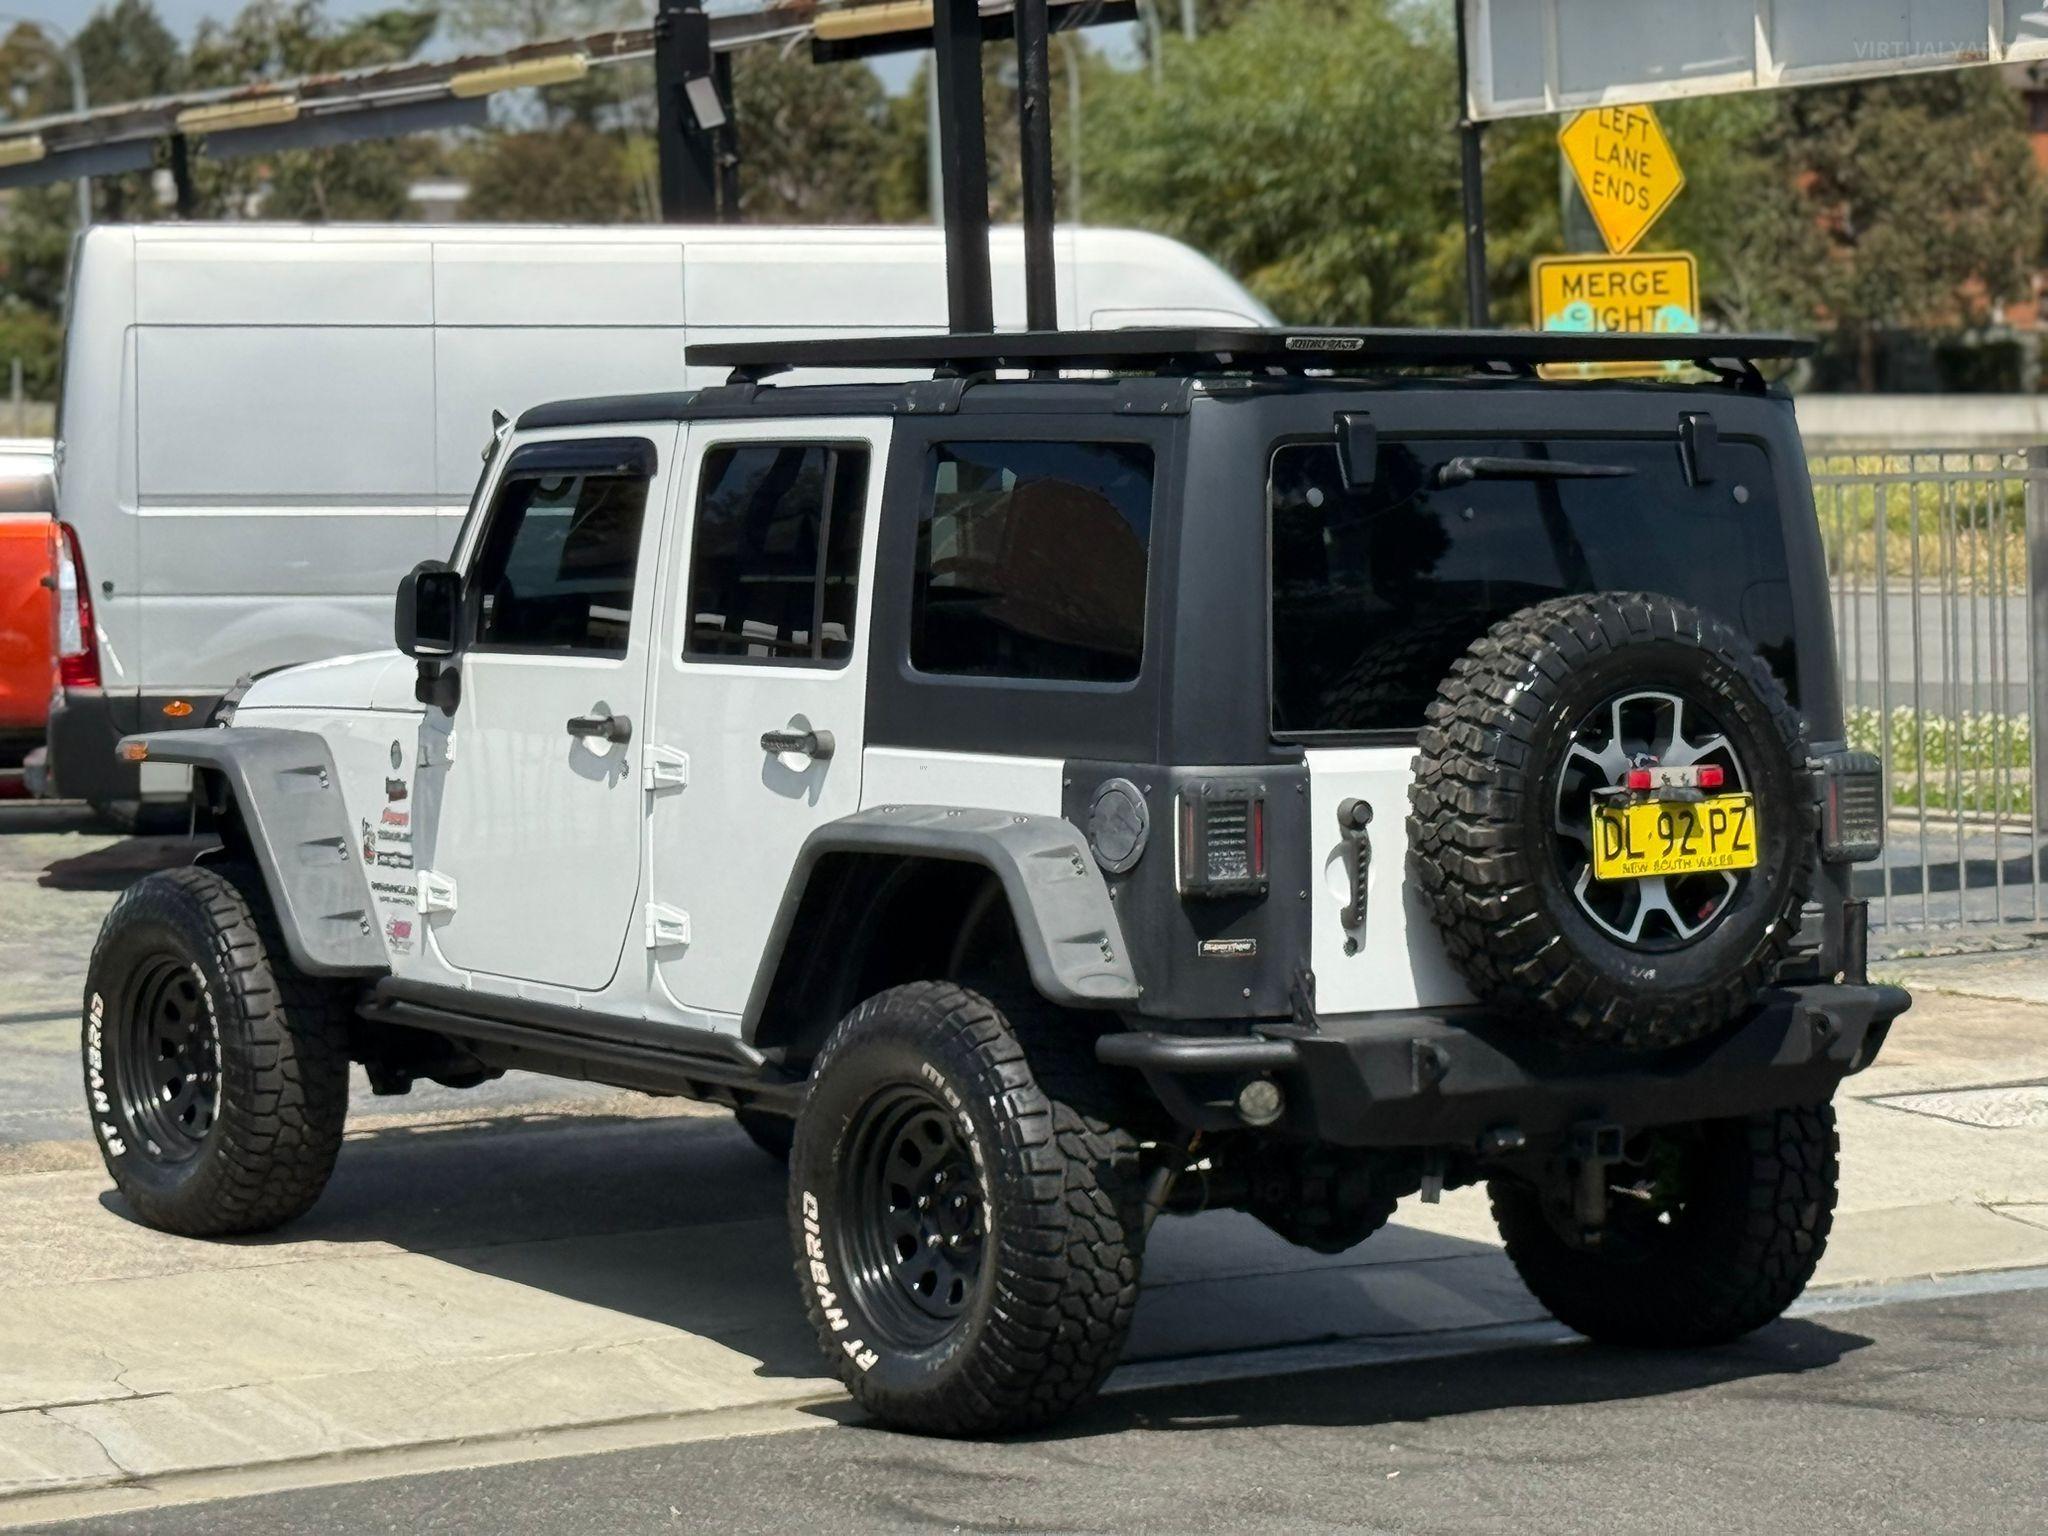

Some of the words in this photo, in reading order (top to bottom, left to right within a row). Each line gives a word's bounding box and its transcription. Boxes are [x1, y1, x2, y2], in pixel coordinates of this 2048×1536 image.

[1598, 106, 1650, 141] LEFT
[1594, 134, 1651, 178] LANE
[1592, 171, 1650, 211] ENDS
[1562, 270, 1670, 299] MERGE
[1604, 815, 1645, 861] DL
[1657, 810, 1697, 857] 92
[1709, 807, 1750, 853] PZ
[802, 1190, 850, 1332] HYBRID
[841, 1338, 880, 1372] RT
